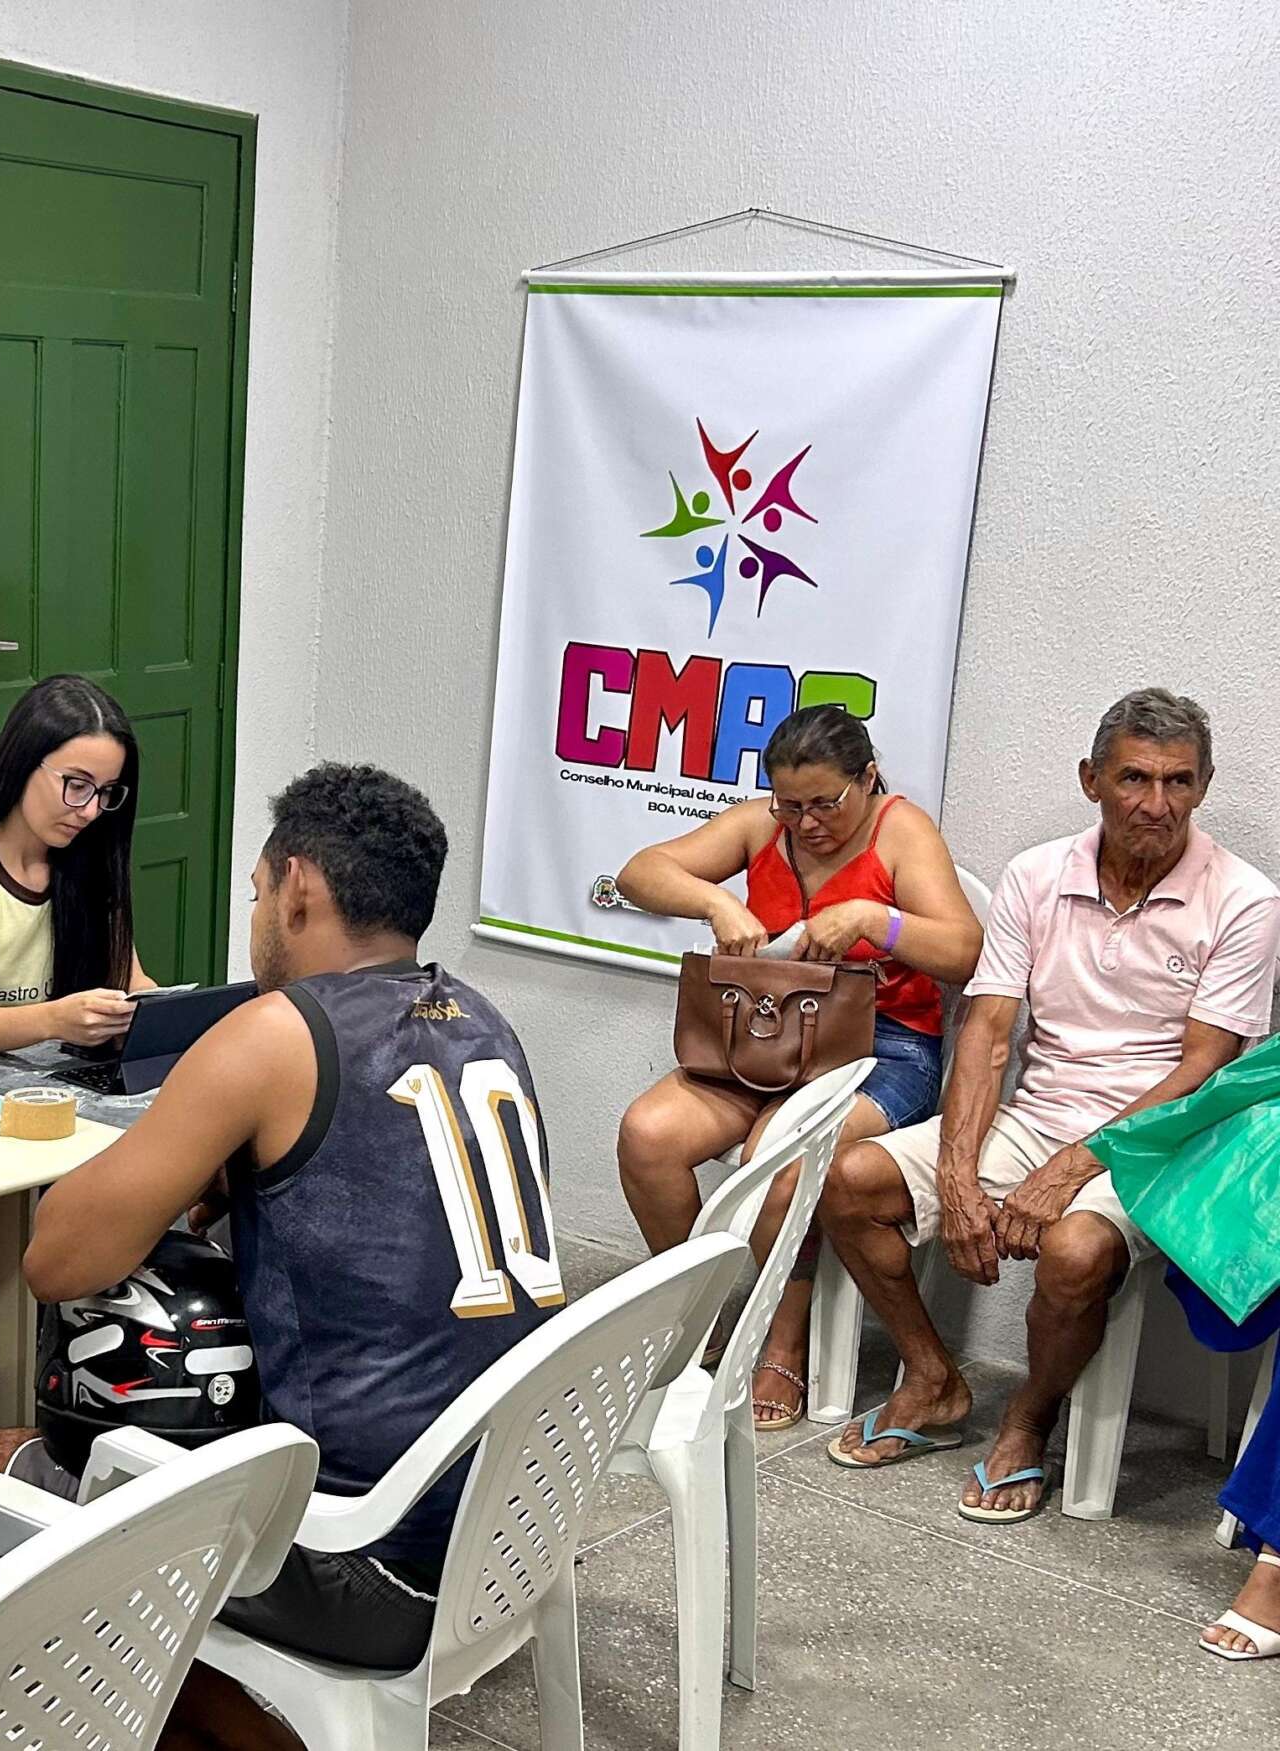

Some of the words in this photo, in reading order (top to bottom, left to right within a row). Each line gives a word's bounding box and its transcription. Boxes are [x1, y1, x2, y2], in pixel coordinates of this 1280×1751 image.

[559, 769, 624, 788] Conselho
[626, 778, 695, 799] Municipal
[696, 789, 715, 802] de
[647, 801, 676, 815] BOA
[678, 805, 720, 820] VIAGE
[385, 1058, 566, 1319] 10
